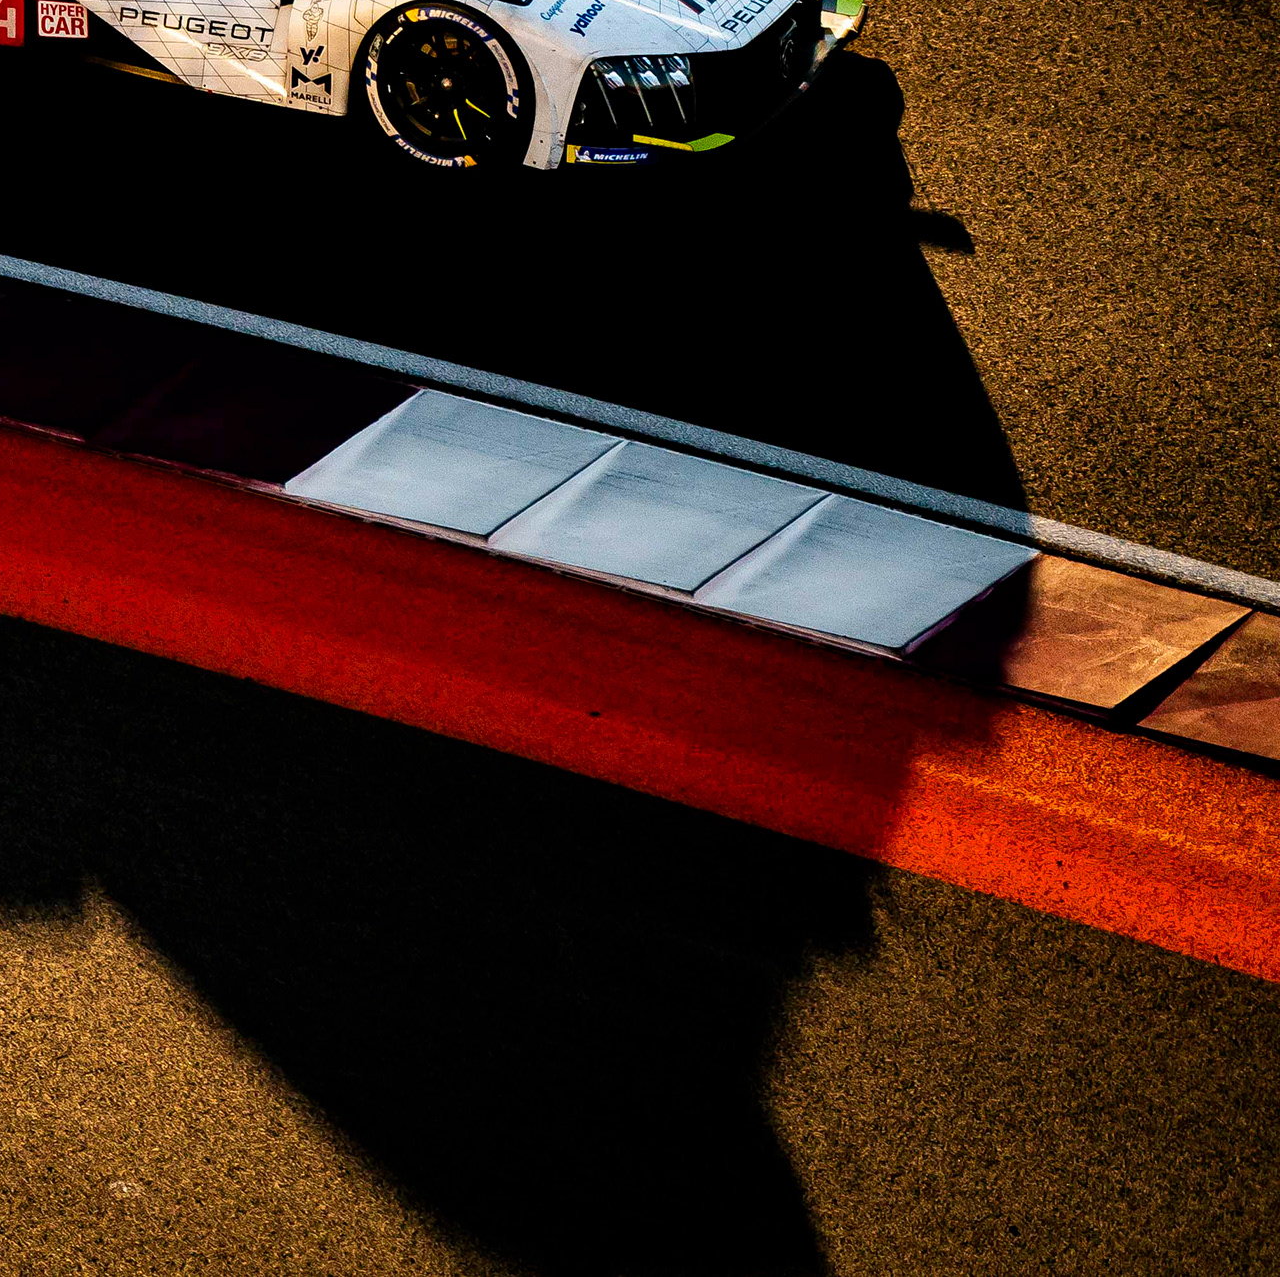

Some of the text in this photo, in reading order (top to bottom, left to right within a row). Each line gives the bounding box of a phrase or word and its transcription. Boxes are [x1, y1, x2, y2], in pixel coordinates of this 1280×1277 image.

[40, 2, 85, 18] HYPER
[40, 16, 85, 36] CAR
[120, 6, 274, 42] PEUGEOT
[429, 9, 488, 39] MICHELIN
[291, 91, 332, 105] MARELLI
[395, 137, 453, 167] MICHELIN
[593, 152, 649, 161] MICHELIN
